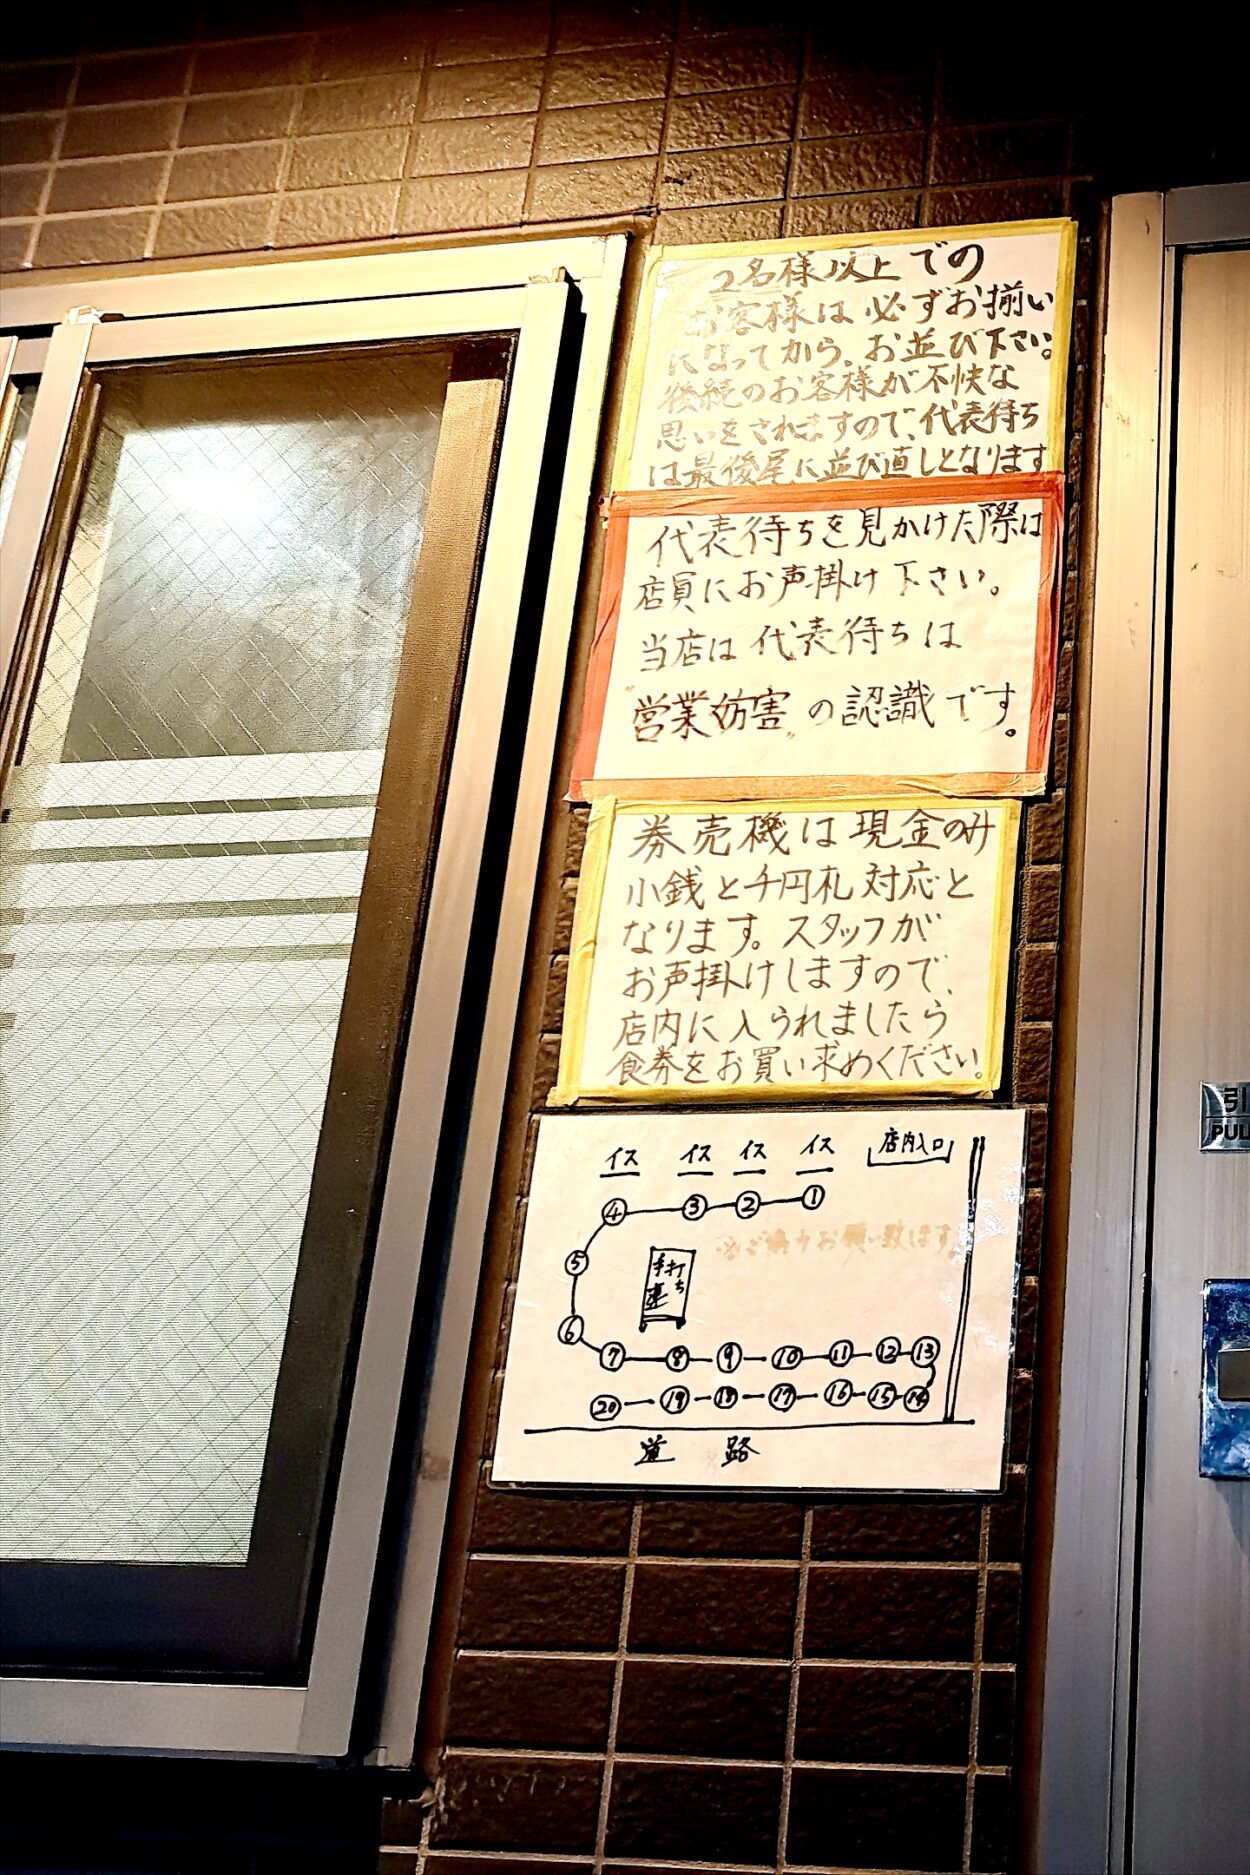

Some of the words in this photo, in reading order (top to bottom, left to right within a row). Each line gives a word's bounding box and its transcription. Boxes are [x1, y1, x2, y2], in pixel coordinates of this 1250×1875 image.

[709, 242, 985, 293] 2名様以上での
[647, 502, 1043, 567] 代表待ちを見かけた際は
[633, 559, 1000, 613] 店員にお声掛け下さい。
[640, 616, 963, 672] 当店は代表待ちは
[628, 809, 996, 864] 券売機は現金のみ
[627, 861, 975, 910] 小銭と千円札対応と
[612, 999, 948, 1051] 店内に入られましたら
[606, 1147, 639, 1168] イス
[680, 1144, 712, 1163] イス
[739, 1139, 768, 1160] イス
[800, 1133, 835, 1157] イス
[877, 1127, 946, 1155] 店内入口
